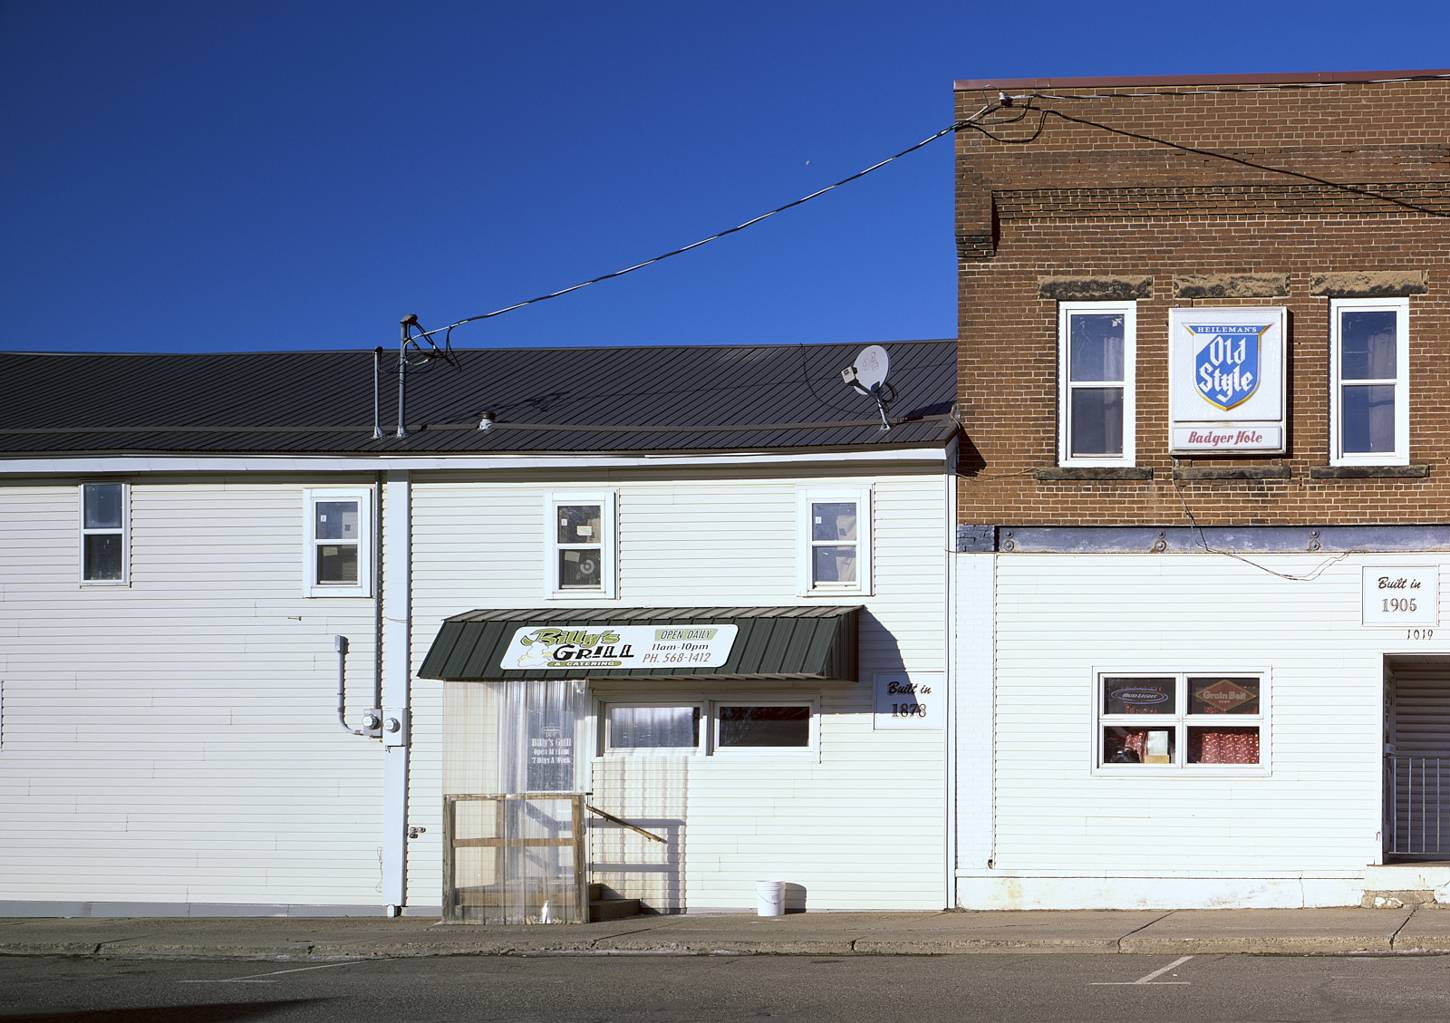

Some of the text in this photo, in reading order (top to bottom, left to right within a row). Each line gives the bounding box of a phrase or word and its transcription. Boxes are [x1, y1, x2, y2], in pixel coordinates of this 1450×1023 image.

[1209, 335, 1246, 366] Old
[1199, 362, 1254, 403] Style
[1188, 431, 1262, 446] Badger Hole
[1377, 576, 1421, 589] Built in
[1382, 598, 1418, 612] 1905
[520, 628, 620, 648] Billy's
[661, 629, 711, 640] OPEN DAILY
[1406, 629, 1434, 641] 1019
[651, 643, 709, 651] 11am-10pm
[642, 652, 712, 663] PH. 568-1412
[888, 681, 932, 695] Built in
[1203, 690, 1228, 700] Grain
[892, 703, 927, 717] 1878
